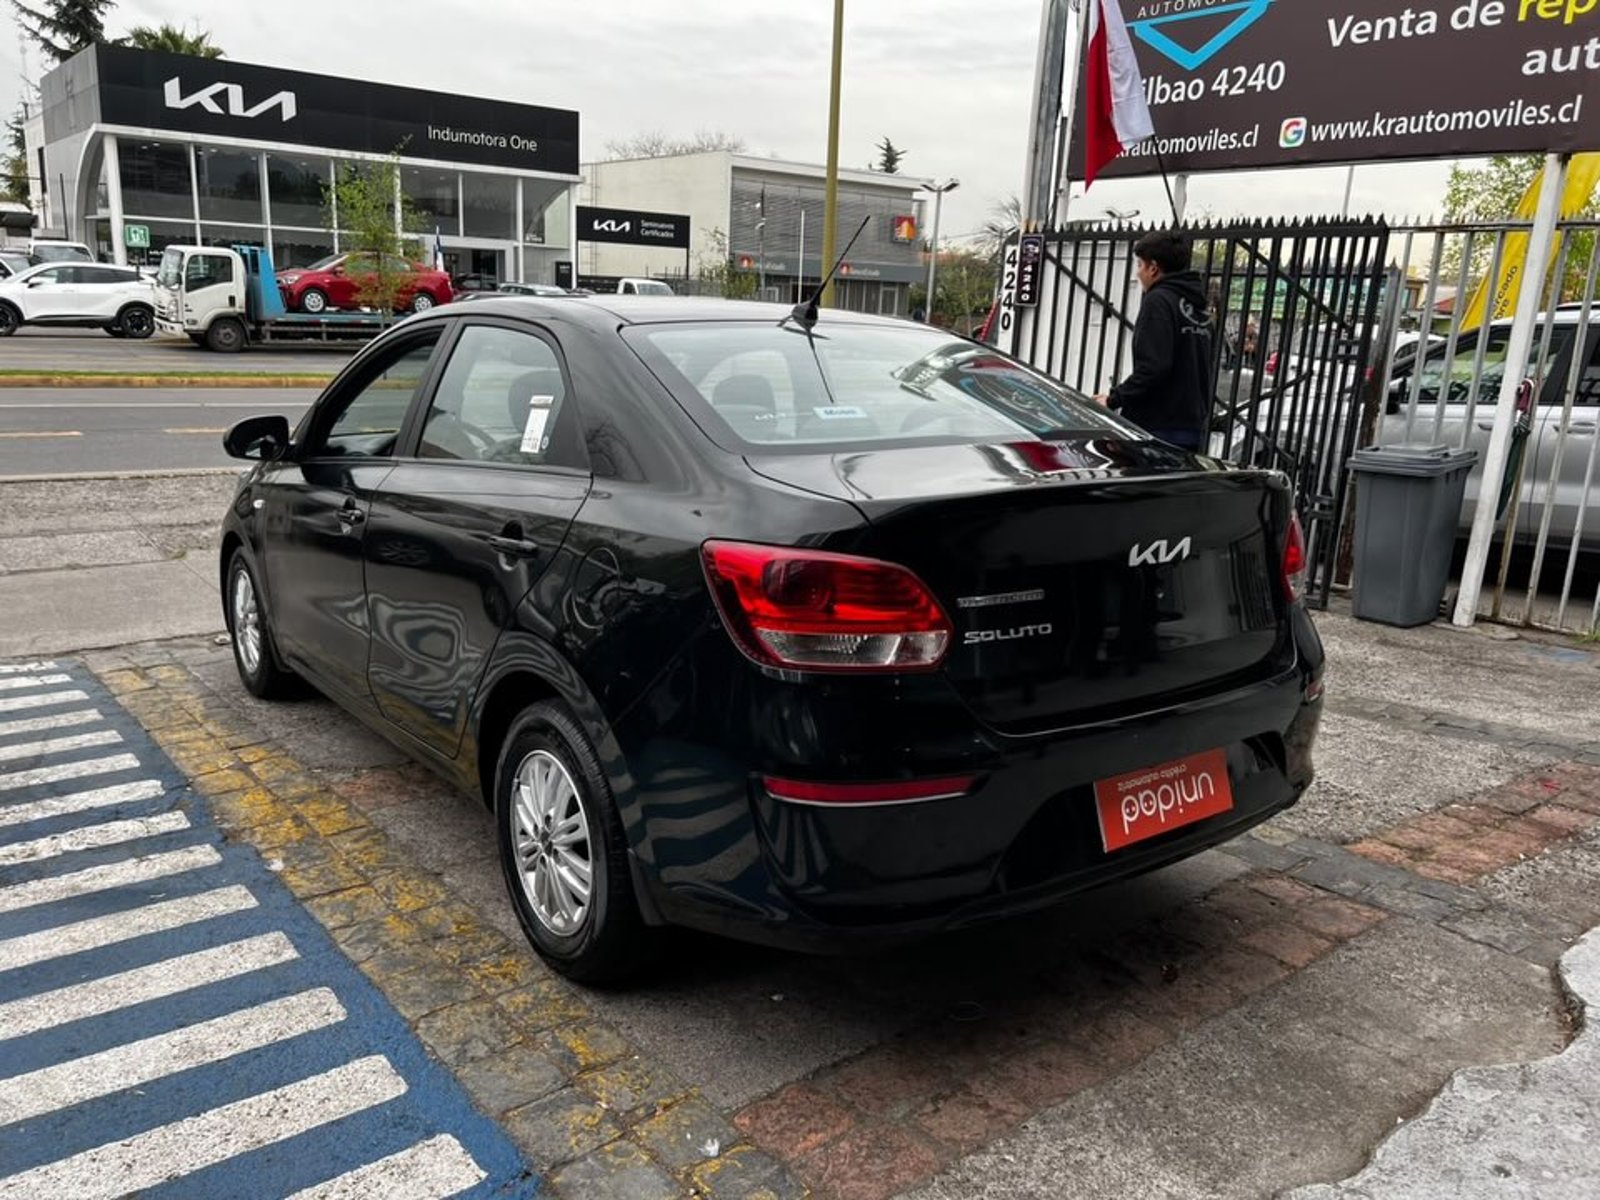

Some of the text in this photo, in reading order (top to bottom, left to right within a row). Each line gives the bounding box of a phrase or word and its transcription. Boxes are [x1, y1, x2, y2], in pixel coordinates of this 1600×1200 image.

[1137, 0, 1226, 18] AUTOMO
[1327, 0, 1597, 47] Venta de rep
[1521, 37, 1600, 76] aut
[163, 76, 297, 122] KIA
[1142, 60, 1286, 105] lbao 4240
[1311, 95, 1583, 142] www.krautomoviles.cl
[427, 125, 538, 152] Indumotora One
[593, 219, 631, 232] KIA
[1001, 248, 1018, 331] 4240
[1021, 264, 1033, 302] 4240
[1128, 536, 1192, 567] KIA
[963, 623, 1052, 645] SOLUTO
[1121, 772, 1215, 835] unidad
